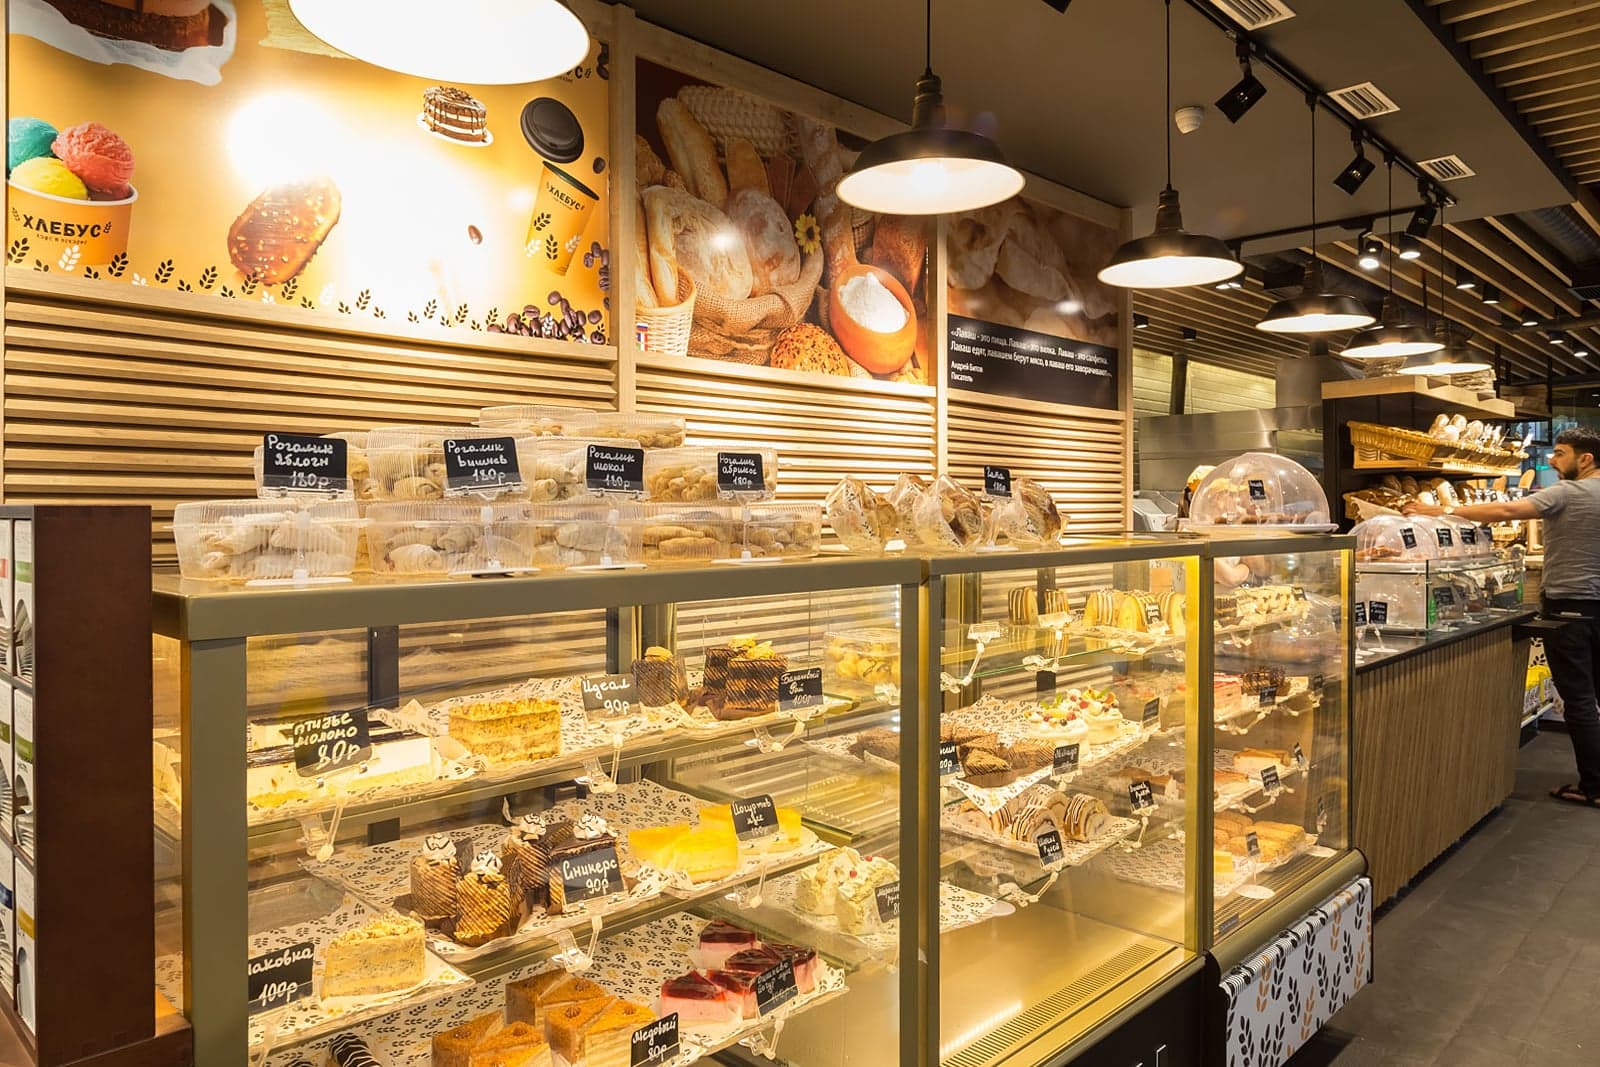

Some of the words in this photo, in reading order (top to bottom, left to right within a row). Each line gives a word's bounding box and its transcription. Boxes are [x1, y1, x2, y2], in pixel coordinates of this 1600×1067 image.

[549, 186, 582, 211] ХЛЕБУС
[23, 214, 101, 238] ХЛЕБУС
[267, 434, 333, 454] Рогалик
[447, 440, 504, 454] Рогалик
[590, 446, 635, 462] Рогалик
[290, 471, 330, 489] 180р
[472, 468, 506, 485] 180р
[605, 474, 630, 491] 180р
[732, 476, 753, 489] 180р
[582, 678, 630, 700] Идеал
[604, 699, 629, 715] 90р
[316, 740, 360, 770] 80р
[940, 759, 953, 773] 00р
[563, 859, 617, 880] Сникерс
[586, 878, 609, 895] 90р
[259, 981, 298, 1007] 100р
[633, 1014, 676, 1046] Медовый
[648, 1044, 667, 1062] 80р
